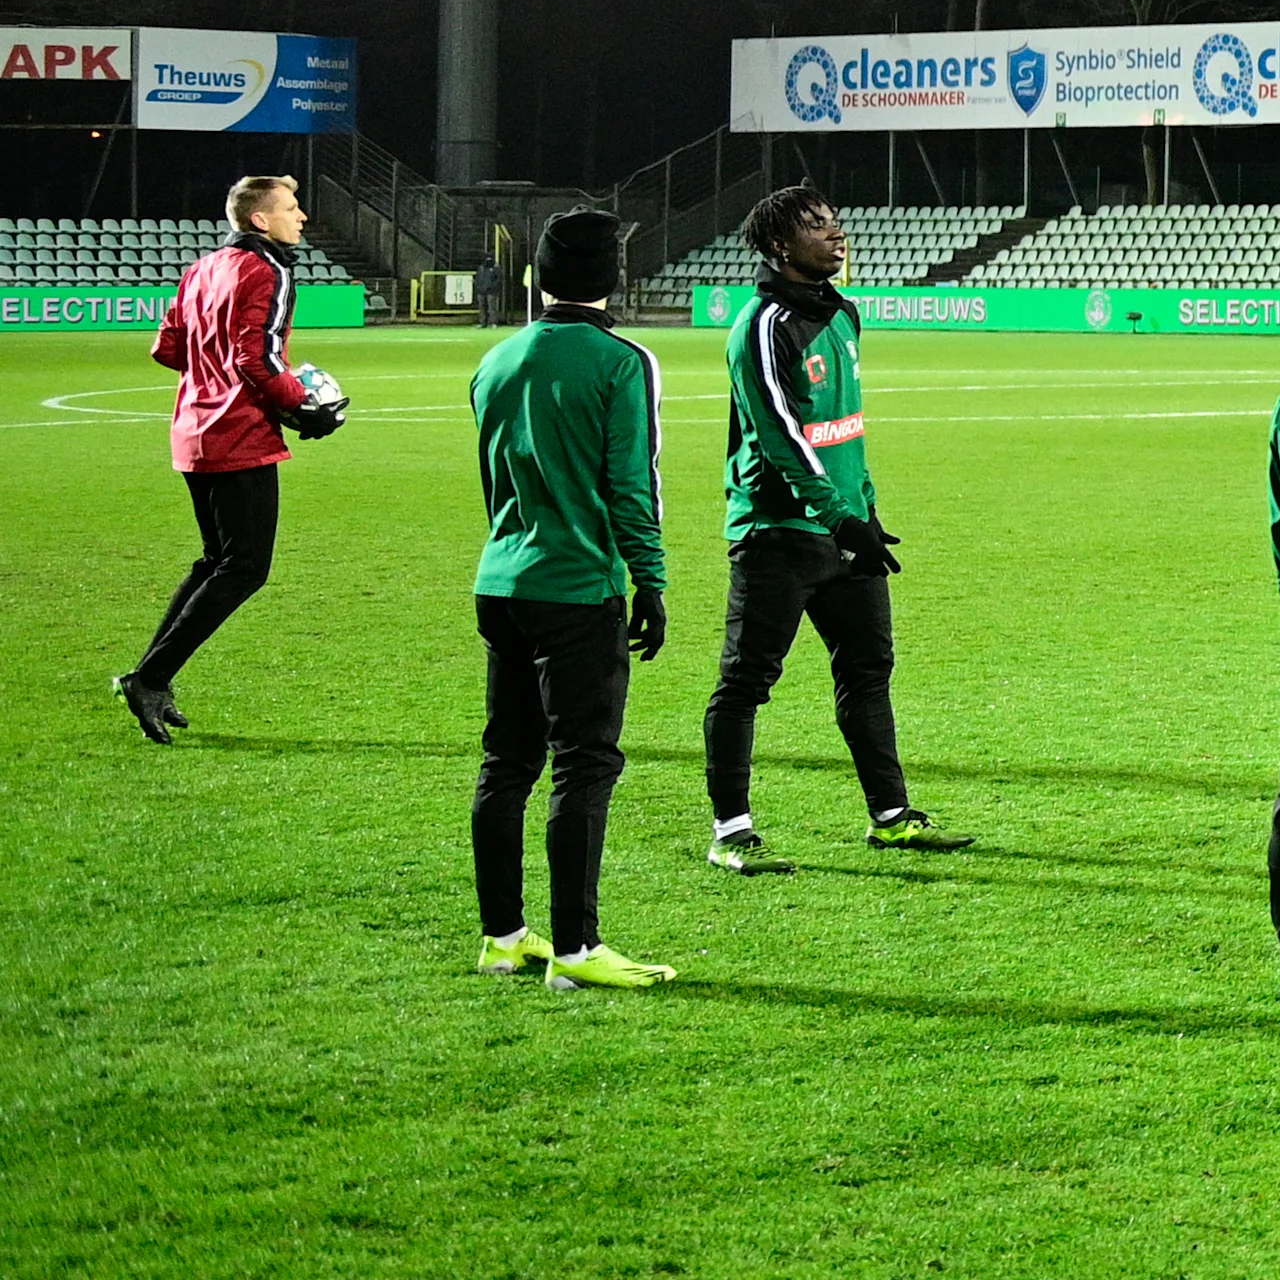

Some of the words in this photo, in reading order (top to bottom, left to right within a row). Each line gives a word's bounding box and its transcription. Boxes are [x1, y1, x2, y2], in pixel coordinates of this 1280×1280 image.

[1, 44, 120, 80] APK
[307, 56, 348, 70] Metaal
[154, 63, 247, 87] Theuws
[276, 75, 348, 92] Assemblage
[1259, 84, 1277, 99] DE
[157, 91, 202, 101] GROEP
[842, 92, 858, 107] DE
[862, 91, 965, 107] SCHOONMAKER
[1055, 81, 1179, 107] Bioprotection
[454, 291, 465, 302] 15
